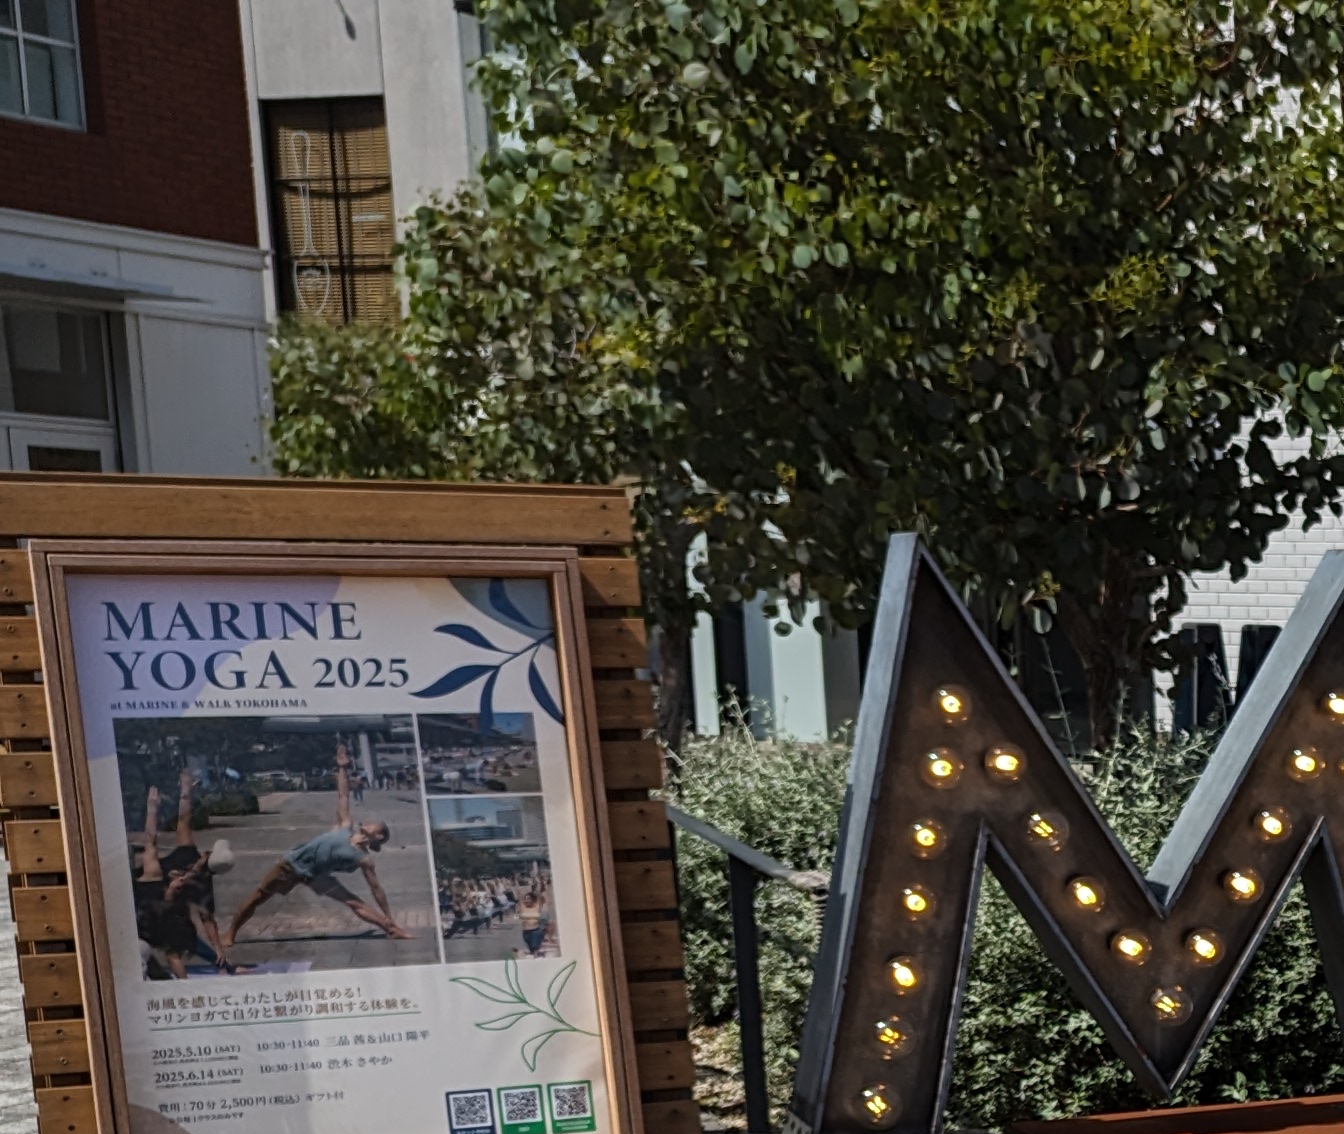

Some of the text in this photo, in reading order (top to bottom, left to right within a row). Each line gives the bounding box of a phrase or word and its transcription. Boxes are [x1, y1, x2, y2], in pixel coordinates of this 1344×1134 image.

[103, 600, 362, 642] MARINE
[104, 649, 410, 692] YOGA 2025
[126, 701, 175, 710] MARINE
[194, 700, 232, 709] WALK
[236, 699, 308, 709] YOKOHAMA
[152, 1046, 212, 1060] 2025.5.10
[155, 1069, 214, 1083] 2025.6.14
[259, 1061, 323, 1074] 10:30-11:40
